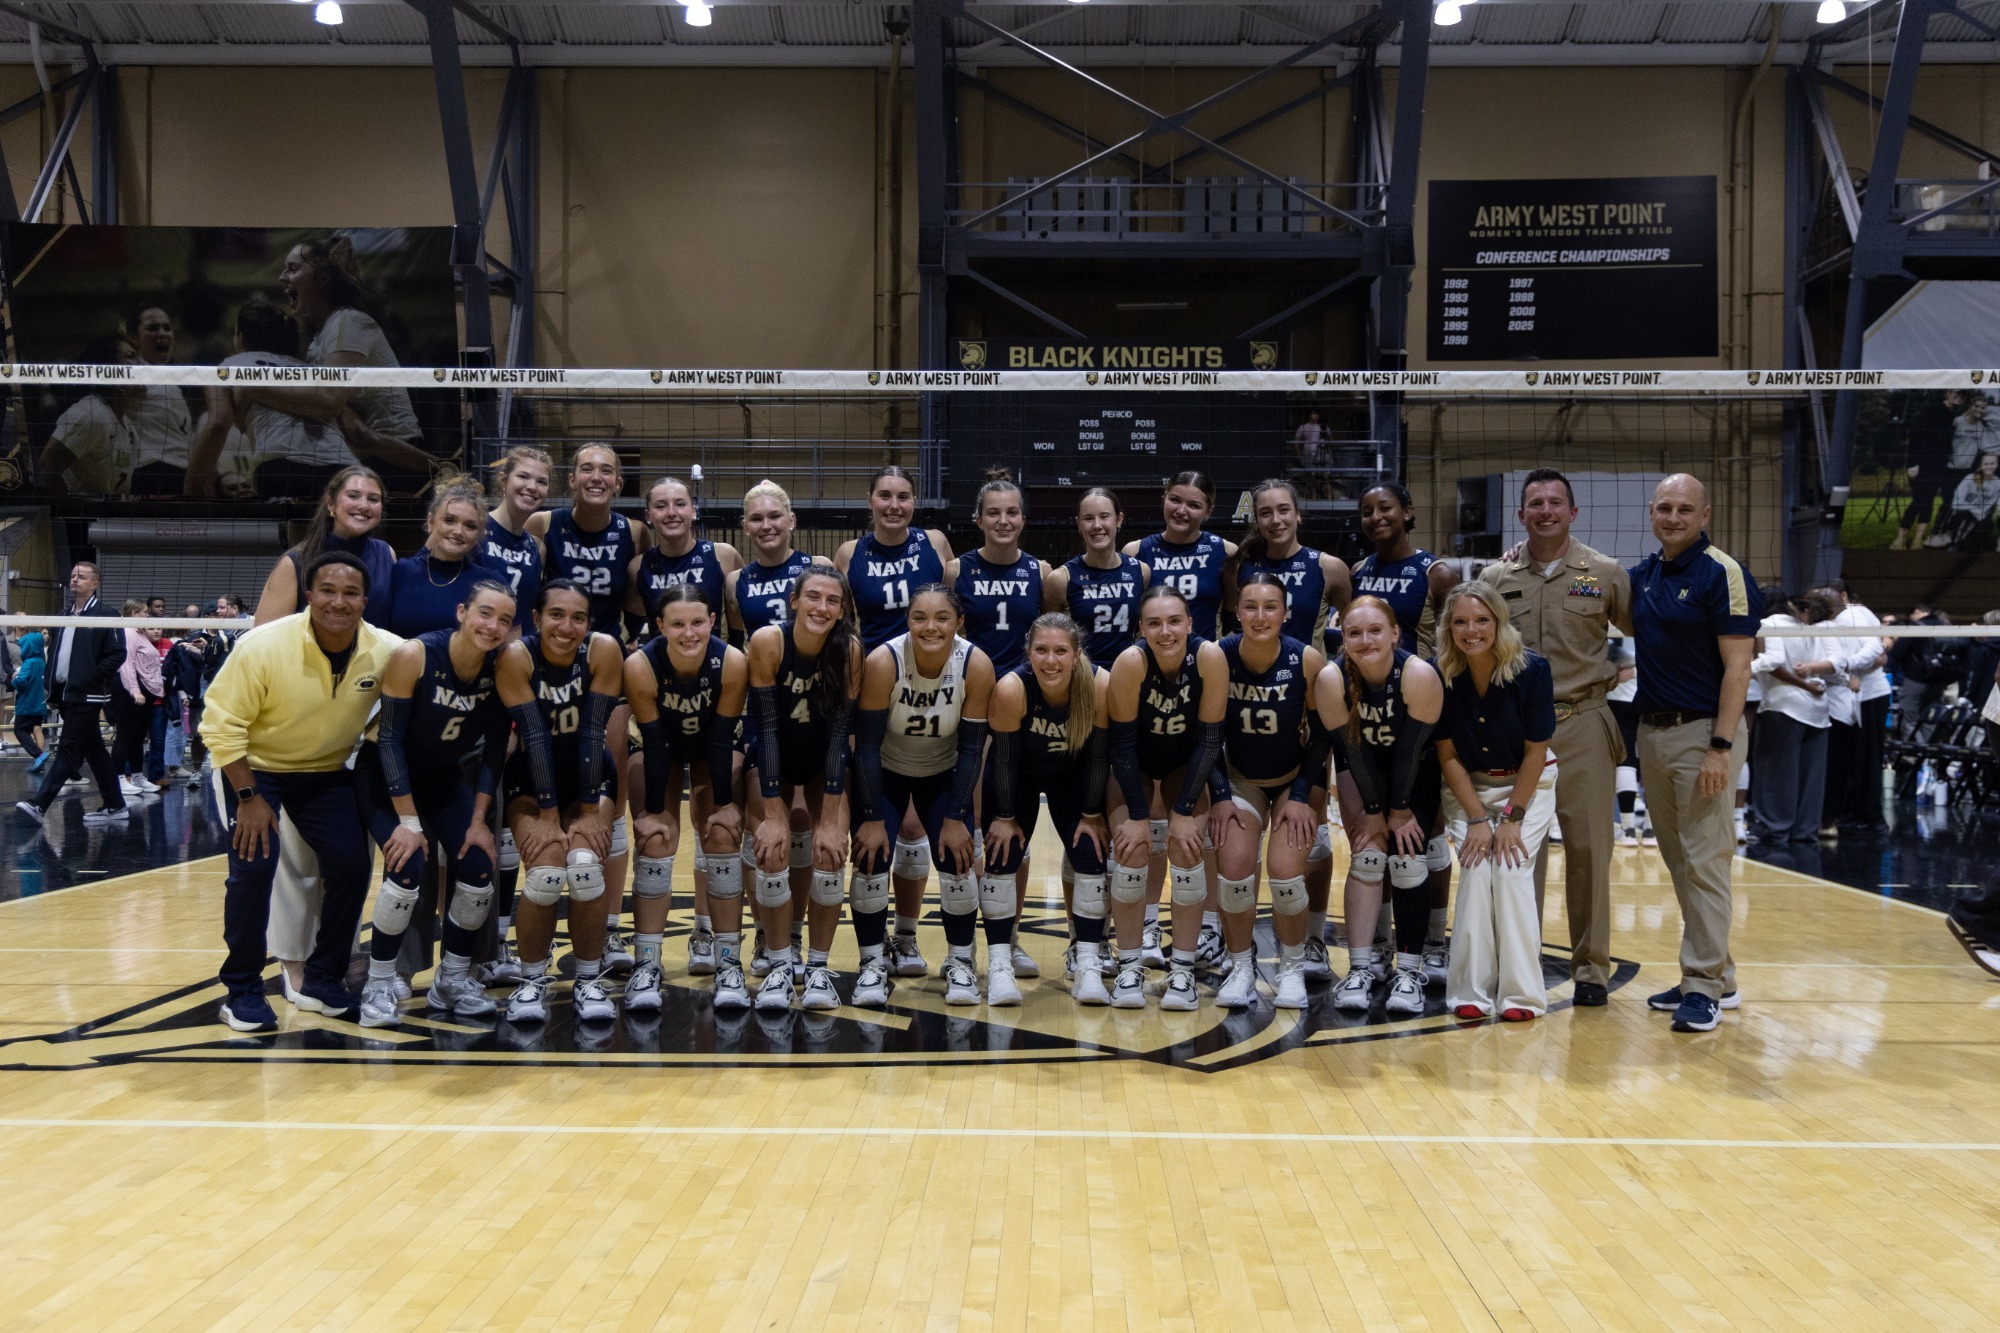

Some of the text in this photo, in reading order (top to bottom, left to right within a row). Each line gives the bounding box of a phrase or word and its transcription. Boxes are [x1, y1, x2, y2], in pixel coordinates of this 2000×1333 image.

[1475, 203, 1666, 227] ARMY WEST POINT
[1469, 229, 1522, 238] WOMEN'S
[1528, 229, 1580, 237] OUTDOOR
[1585, 228, 1622, 236] TRACK
[1639, 227, 1673, 235] FIELD
[1476, 248, 1671, 264] CONFERENCE CHAMPIONSHIPS
[1443, 279, 1469, 289] 1992
[1509, 278, 1534, 288] 1997
[1443, 293, 1469, 303] 1993
[1509, 292, 1534, 303] 1998
[1443, 307, 1469, 317] 1994
[1509, 306, 1536, 317] 2008
[1443, 321, 1469, 331] 1995
[1508, 320, 1534, 331] 2025
[1443, 335, 1469, 345] 1996
[1009, 346, 1223, 368] BLACK KNIGHTS
[19, 365, 130, 379] ARMY WEST POINT
[235, 367, 348, 381] ARMY WEST POINT
[451, 369, 564, 383] ARMY WEST POINT
[668, 370, 782, 384] ARMY WEST POINT
[885, 372, 1000, 386] ARMY WEST POINT
[1103, 372, 1218, 385] ARMY WEST POINT
[1322, 372, 1438, 385] ARMY WEST POINT
[1542, 372, 1660, 386] ARMY WEST POINT
[1764, 371, 1883, 385] ARMY WEST POINT
[1102, 410, 1133, 418] PERIOD
[1079, 432, 1104, 440] BONUS
[1131, 432, 1156, 440] BONUS
[1034, 442, 1054, 450] WON
[563, 541, 619, 561] NAVY
[867, 555, 920, 577] NAVY
[1153, 554, 1210, 571] NAVY
[506, 566, 522, 595] 7
[572, 565, 611, 595] 22
[651, 567, 704, 589] NAVY
[1359, 576, 1412, 594] NAVY
[882, 580, 910, 610] 11
[973, 580, 1029, 596] NAVY
[1082, 583, 1135, 599] NAVY
[995, 602, 1010, 630] 1
[1093, 604, 1129, 632] 24
[898, 687, 954, 708] NAVY
[1228, 683, 1289, 702] NAVY
[662, 688, 712, 714] NAVY
[790, 698, 811, 724] 4
[441, 716, 466, 741] 6
[550, 705, 580, 736] 10
[681, 717, 700, 736] 9
[905, 715, 941, 738] 21
[1030, 716, 1068, 738] NAV
[1150, 714, 1186, 735] 16
[1240, 707, 1278, 735] 13
[1362, 726, 1396, 747] 15
